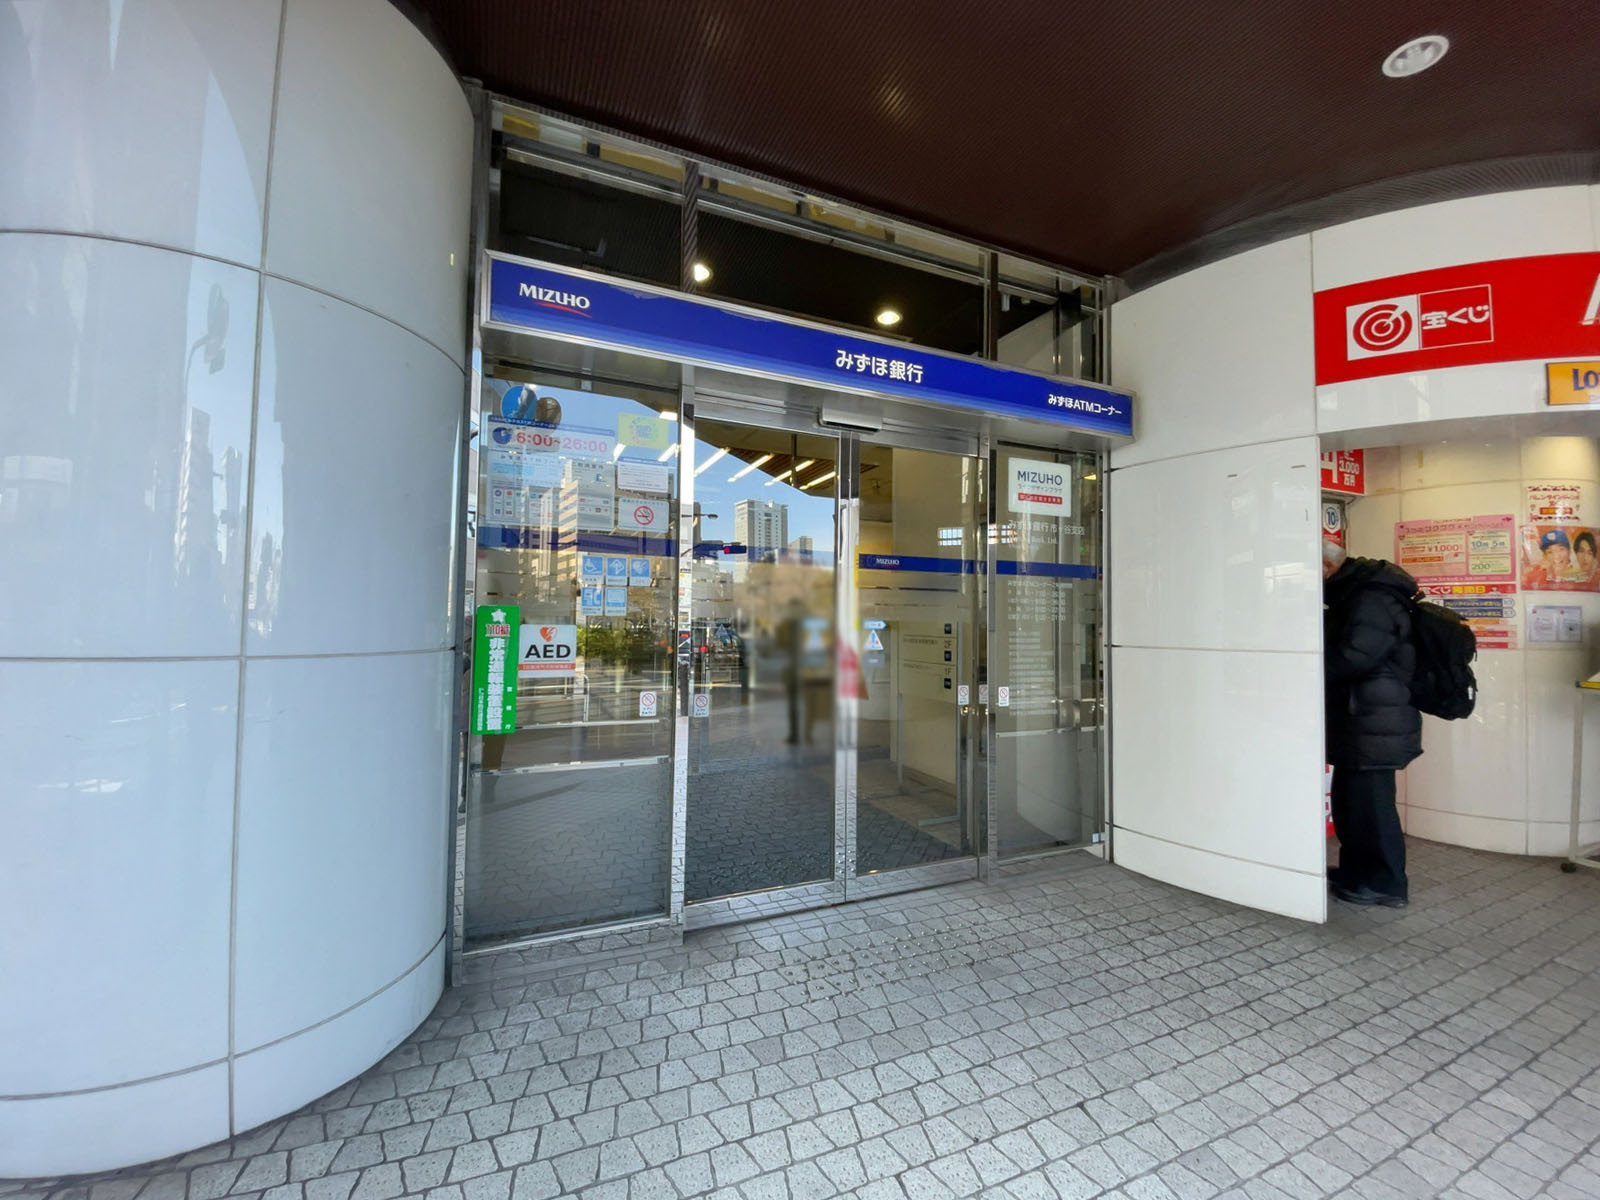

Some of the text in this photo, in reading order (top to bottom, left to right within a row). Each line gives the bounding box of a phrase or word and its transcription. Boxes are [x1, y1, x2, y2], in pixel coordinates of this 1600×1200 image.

[519, 282, 590, 309] MIZUHO
[1421, 304, 1490, 330] 宝くじ
[835, 349, 924, 383] みずほ銀行
[1572, 368, 1600, 391] LO
[1048, 393, 1123, 416] みずほATMコーナー
[1017, 470, 1063, 486] MIZUHO
[524, 644, 571, 659] AED
